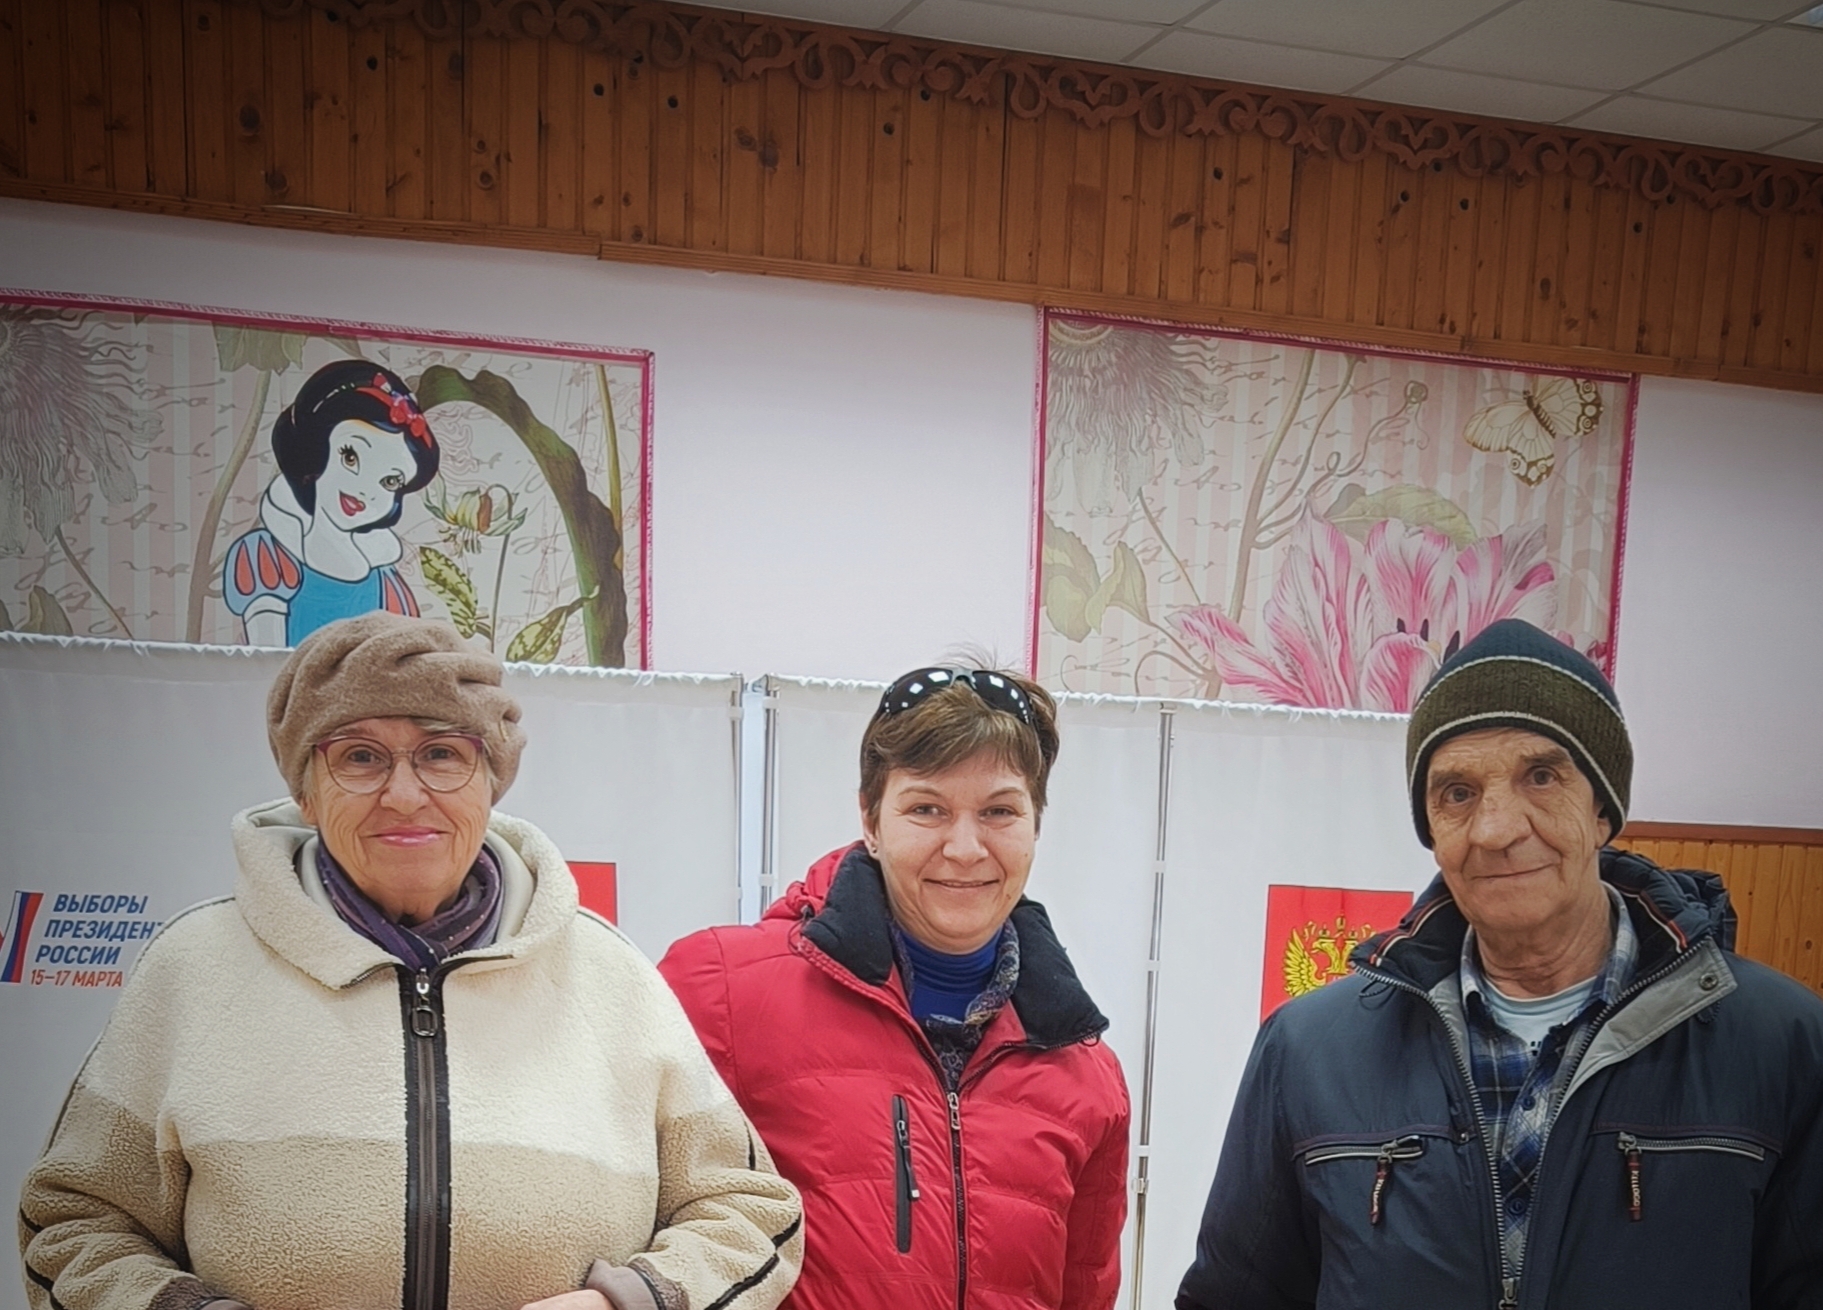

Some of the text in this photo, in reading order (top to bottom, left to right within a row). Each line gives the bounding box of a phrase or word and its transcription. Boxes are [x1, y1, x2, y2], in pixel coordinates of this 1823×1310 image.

[53, 894, 148, 913] ВЫБОРЫ
[44, 919, 164, 941] ПРЕЗИДЕН
[35, 945, 121, 964] РОССИИ
[72, 971, 123, 987] МАРТА
